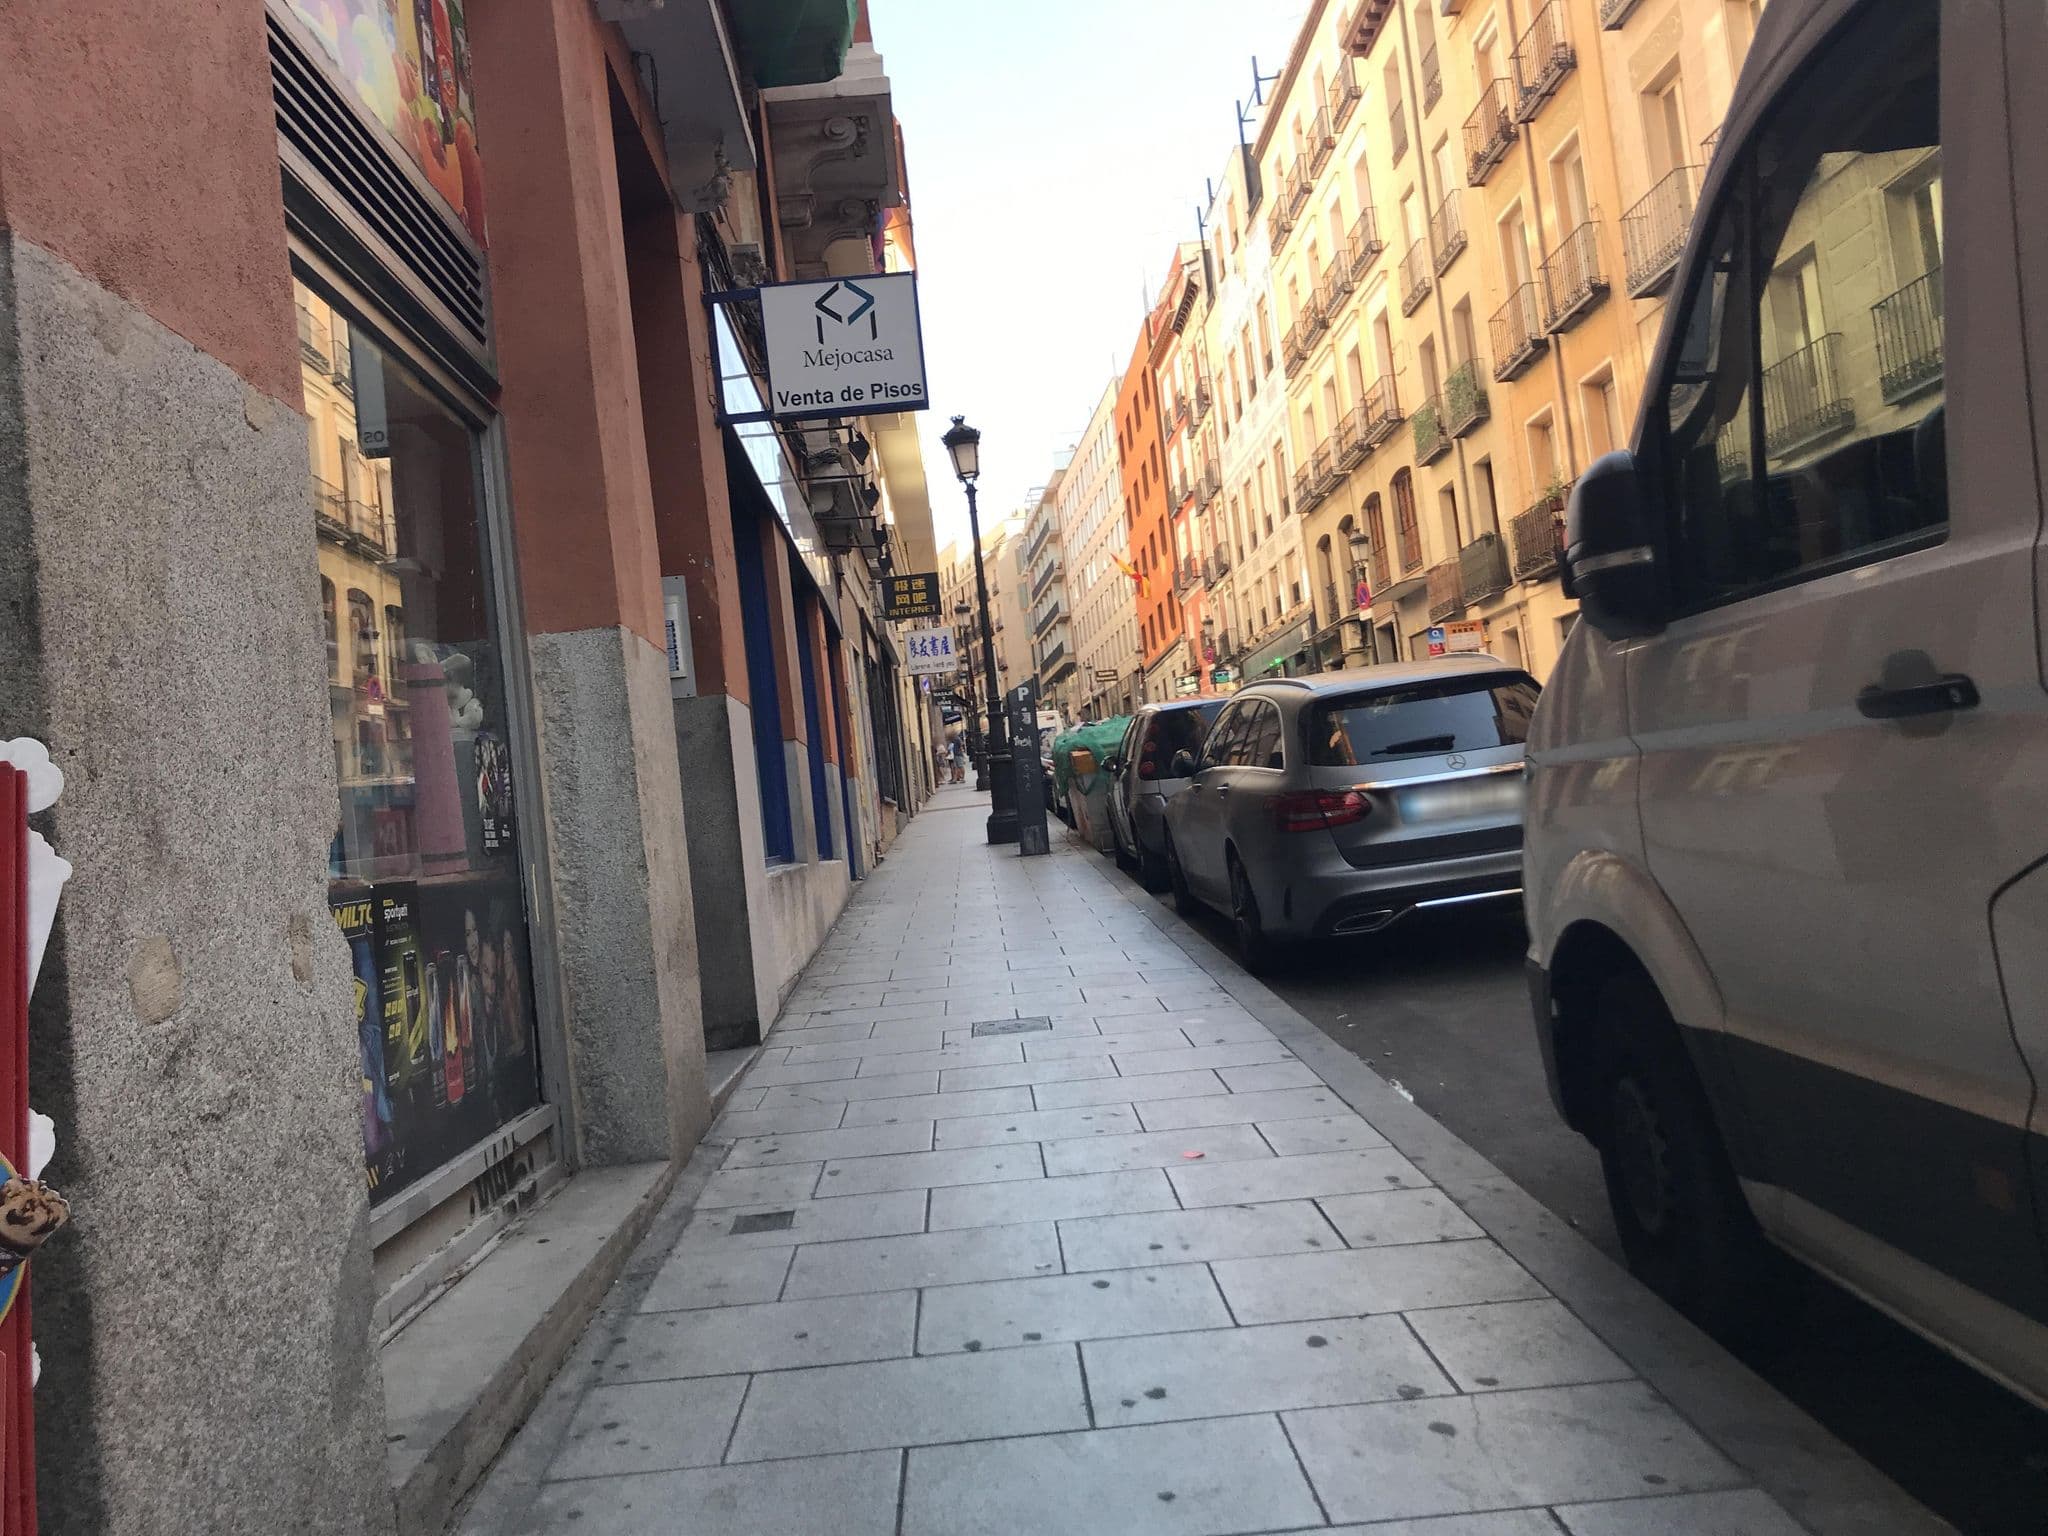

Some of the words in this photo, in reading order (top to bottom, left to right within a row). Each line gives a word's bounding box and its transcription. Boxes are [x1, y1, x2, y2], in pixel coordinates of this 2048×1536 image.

[803, 347, 894, 371] Mejocasa
[777, 388, 834, 407] Venta
[840, 385, 864, 402] de
[871, 382, 922, 399] Pisos
[889, 604, 936, 616] INTERNET
[1017, 686, 1029, 702] P
